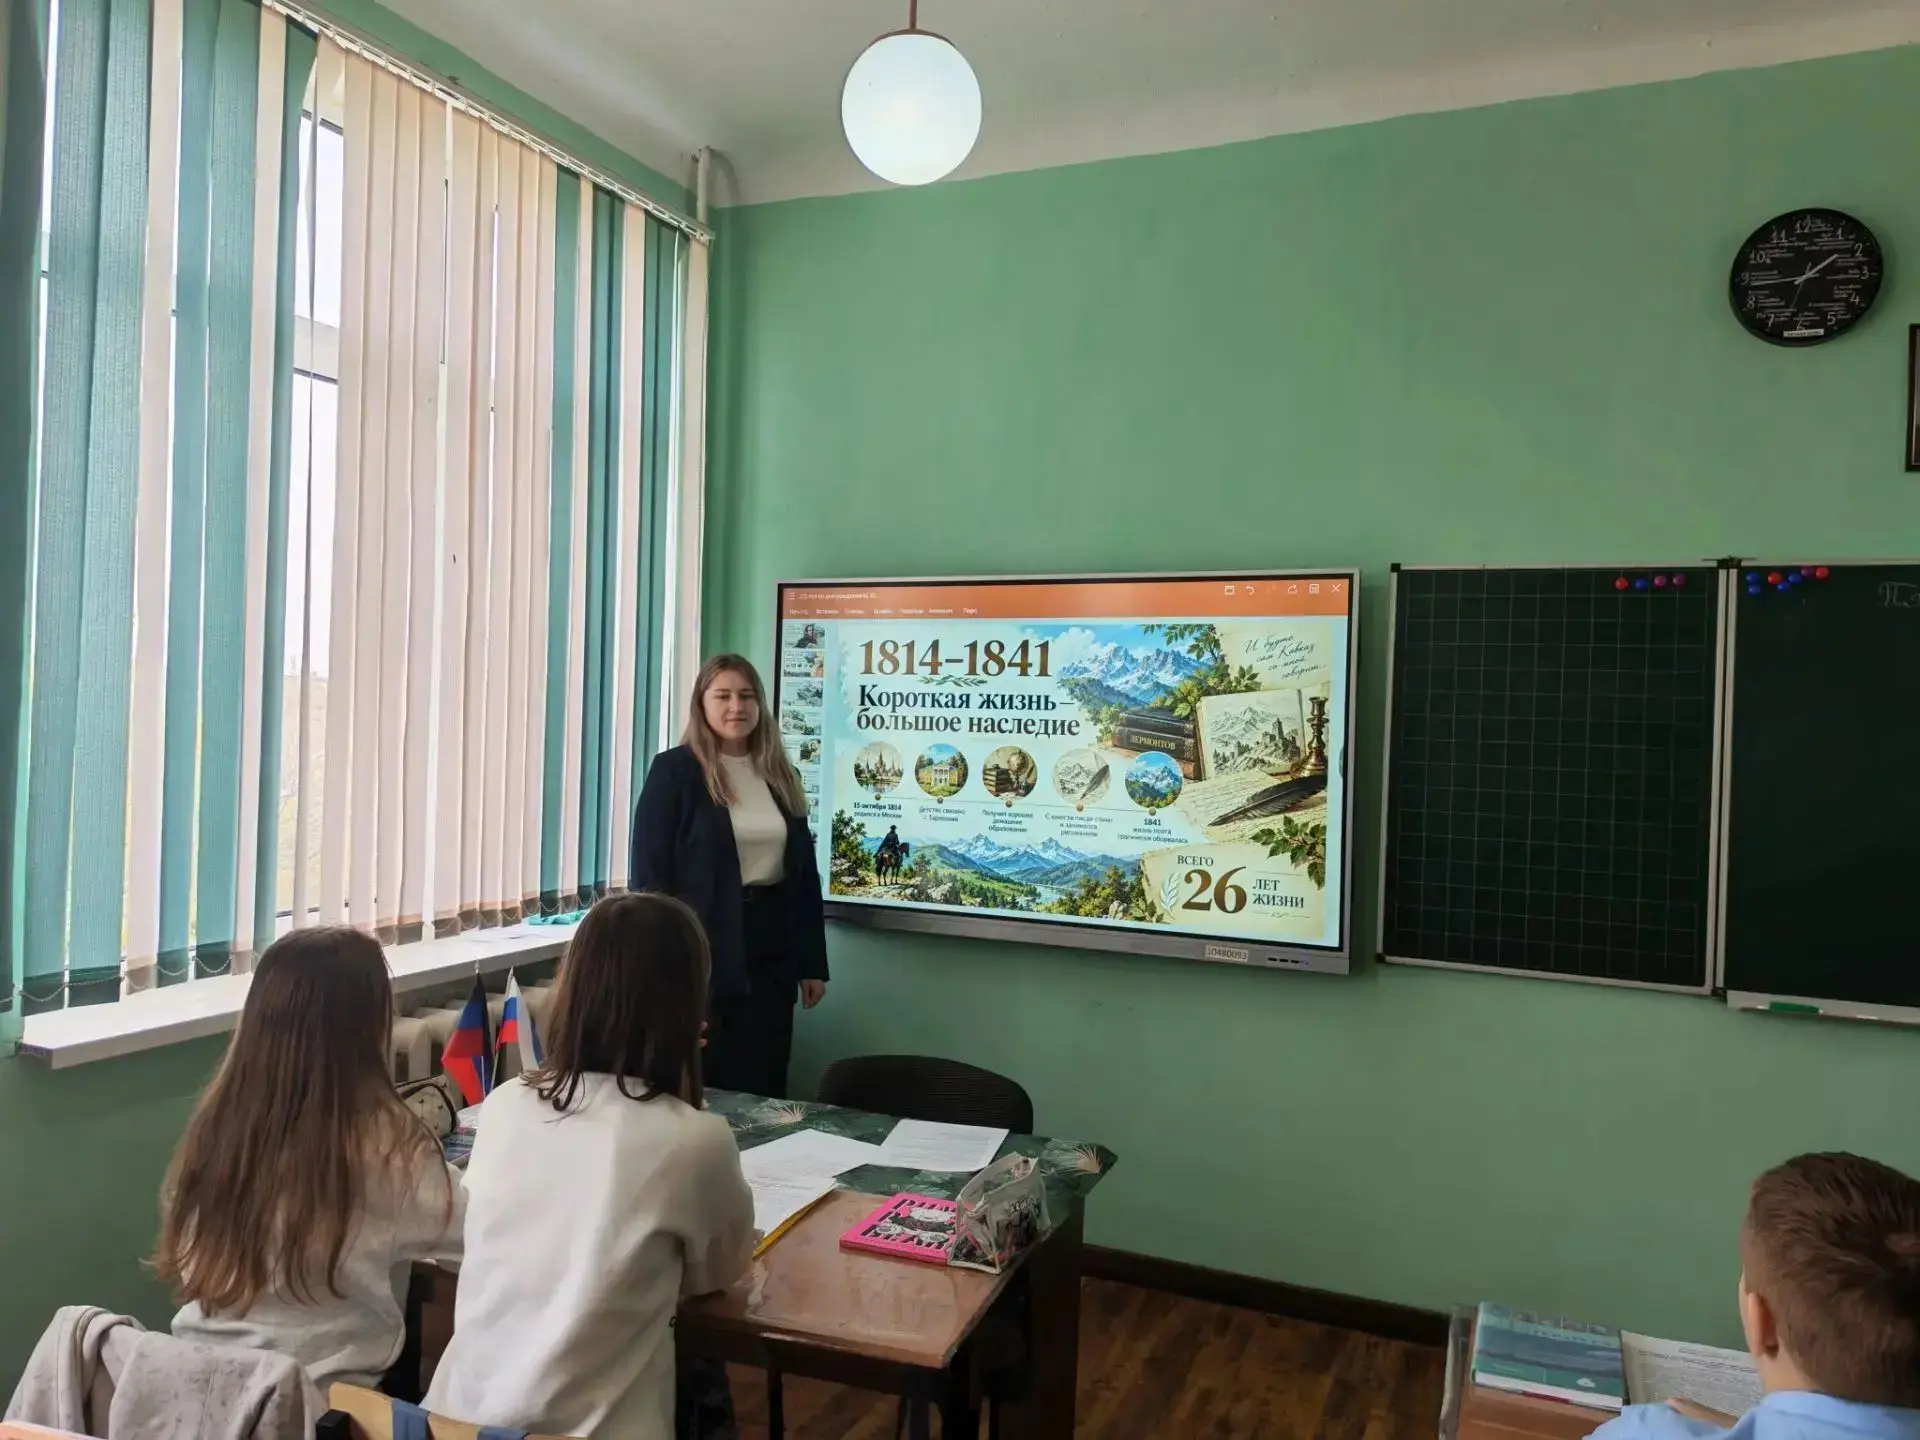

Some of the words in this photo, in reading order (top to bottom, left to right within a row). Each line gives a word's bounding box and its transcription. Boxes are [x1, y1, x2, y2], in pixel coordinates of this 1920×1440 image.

[1794, 215, 1811, 233] 12
[1771, 229, 1787, 243] 11
[1854, 243, 1863, 256] 2
[1827, 312, 1836, 325] 5
[858, 685, 971, 713] Короткая
[856, 707, 962, 732] большое
[968, 716, 1081, 738] наследие
[1144, 818, 1161, 826] 1841
[1177, 855, 1214, 867] ВСЕГО
[1181, 866, 1248, 914] 26
[1252, 879, 1280, 892] ЛЕТ
[1252, 893, 1304, 908] ЖИЗНИ
